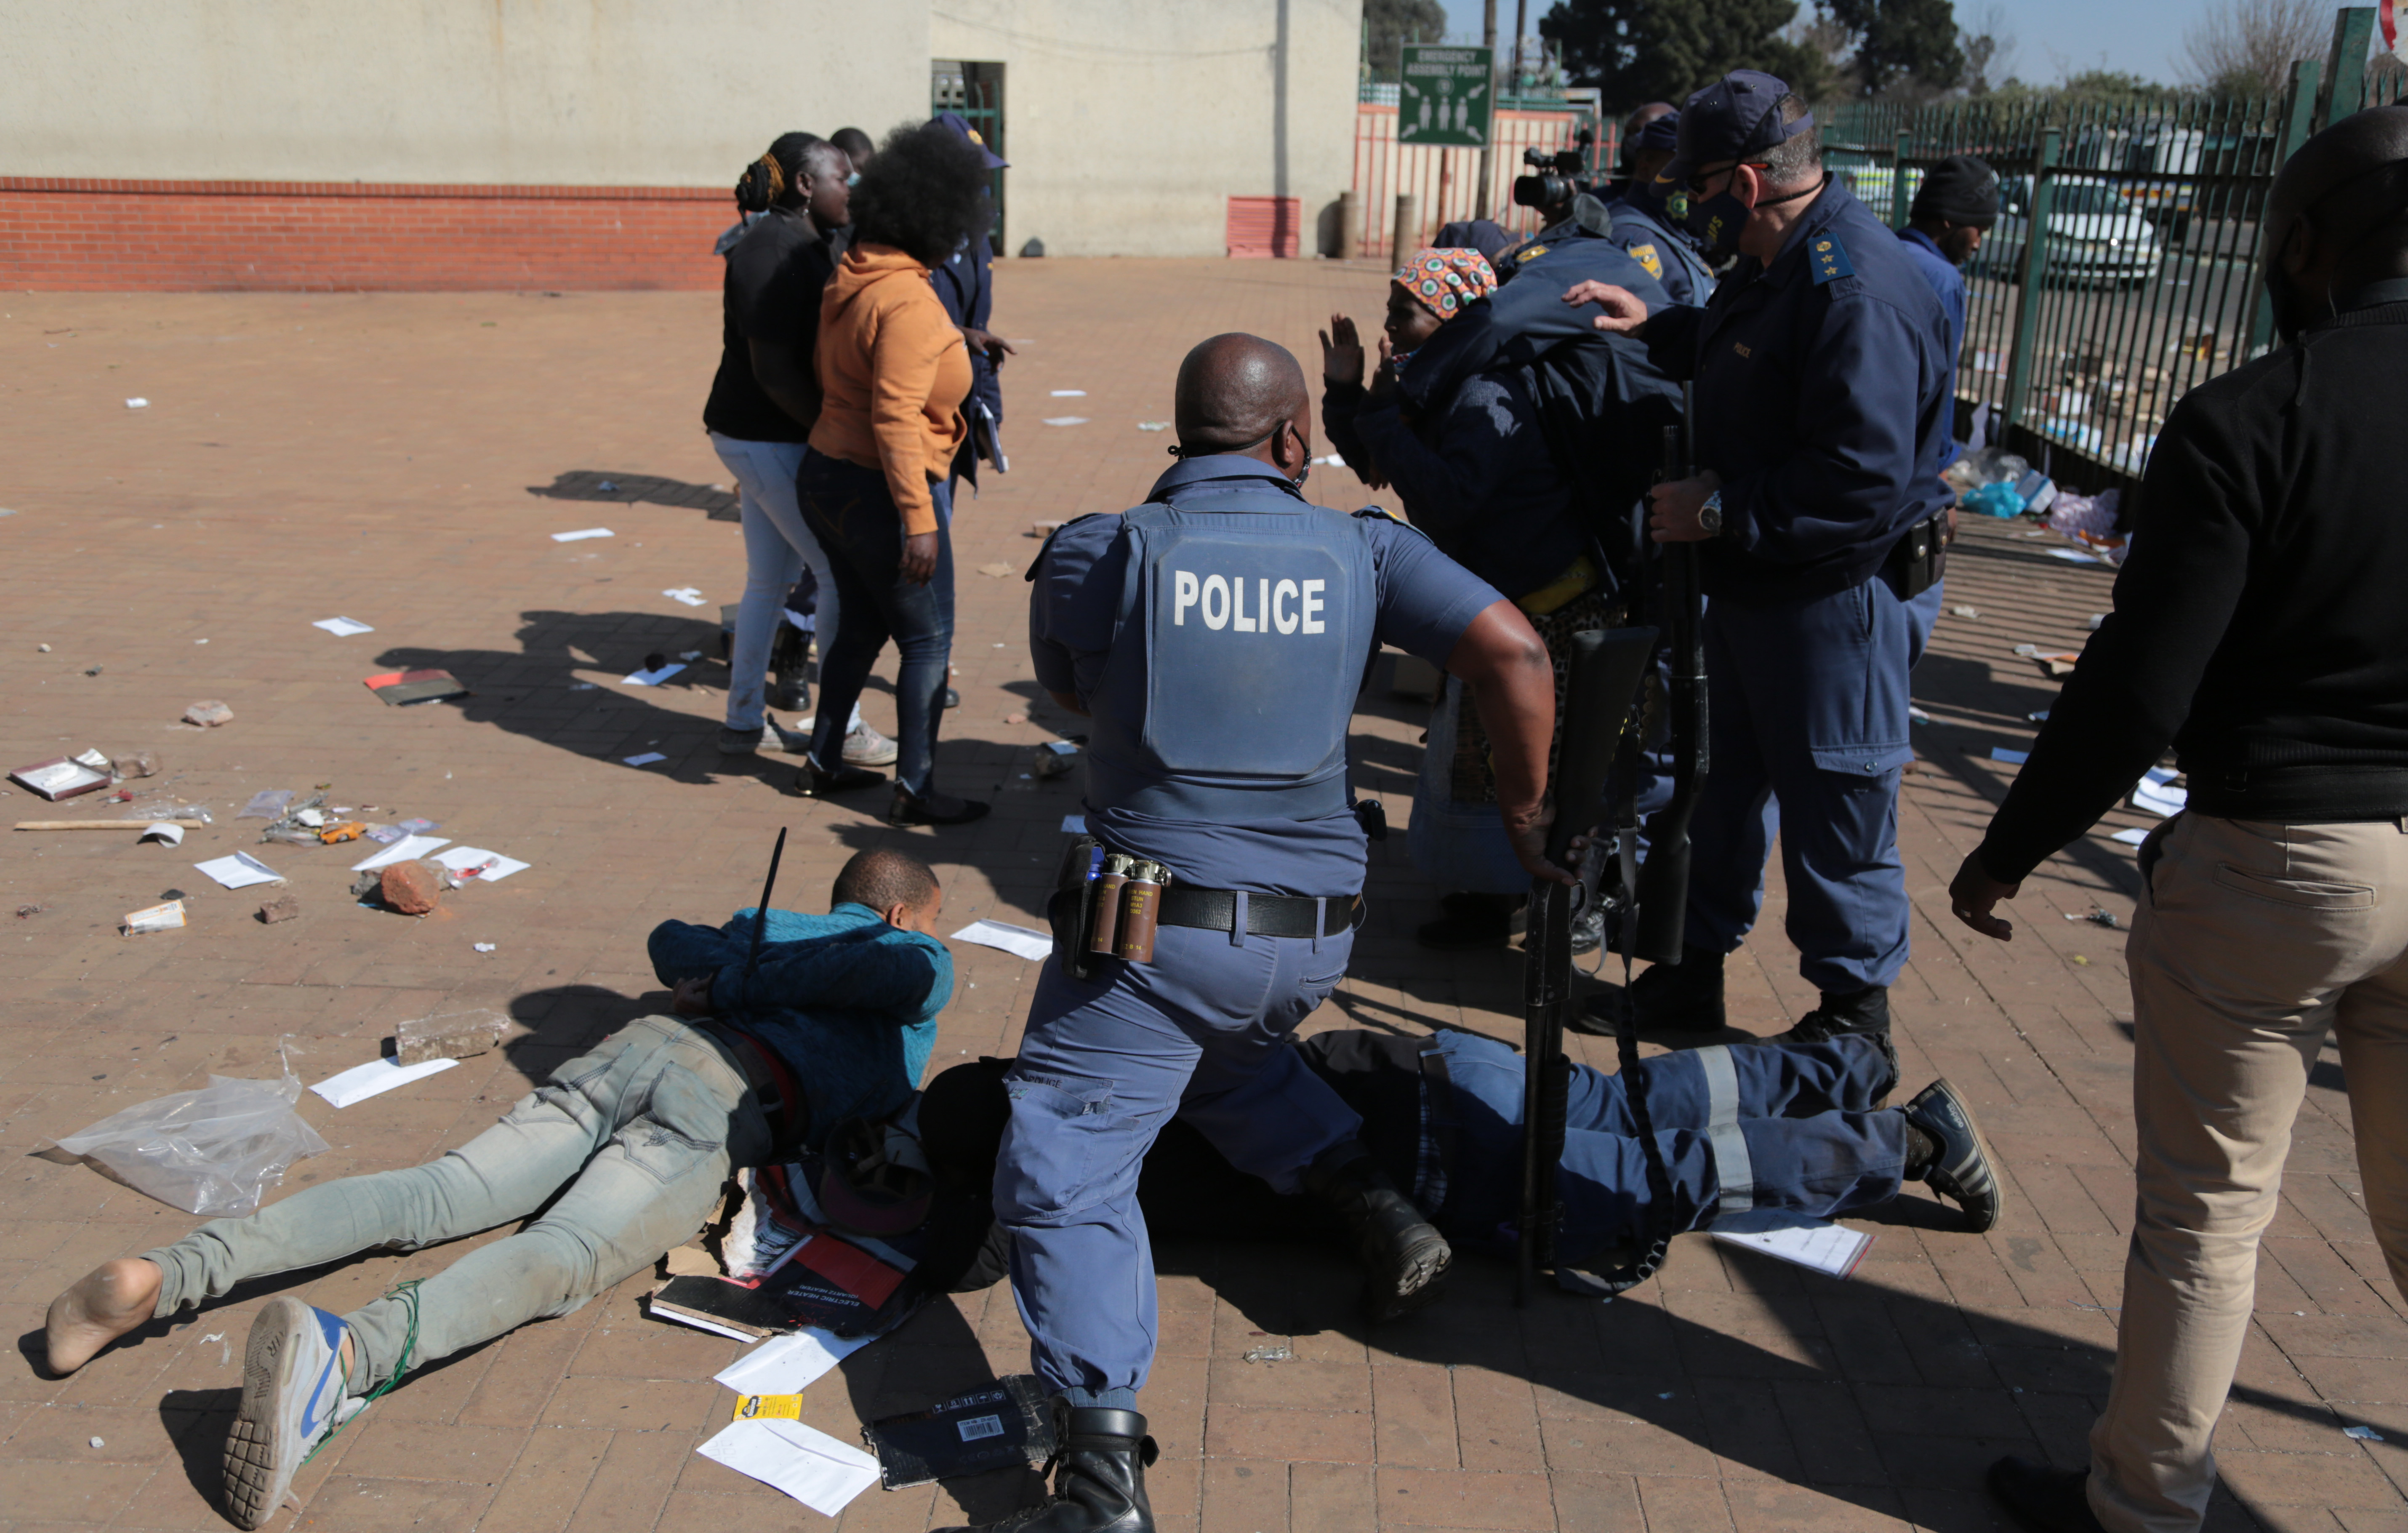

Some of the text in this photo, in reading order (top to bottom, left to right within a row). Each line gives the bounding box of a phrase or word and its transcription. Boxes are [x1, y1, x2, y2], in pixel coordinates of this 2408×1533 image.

[1417, 50, 1476, 61] EMERGENCY
[1406, 63, 1487, 77] ASSEMBLY POINT
[1175, 570, 1325, 635] POLICE
[1946, 1103, 1964, 1128] adidas
[787, 1290, 860, 1306] ELECTRIC HEATER
[799, 1285, 858, 1298] (QUARTZ HEATER)
[748, 1399, 756, 1416] Bonanza
